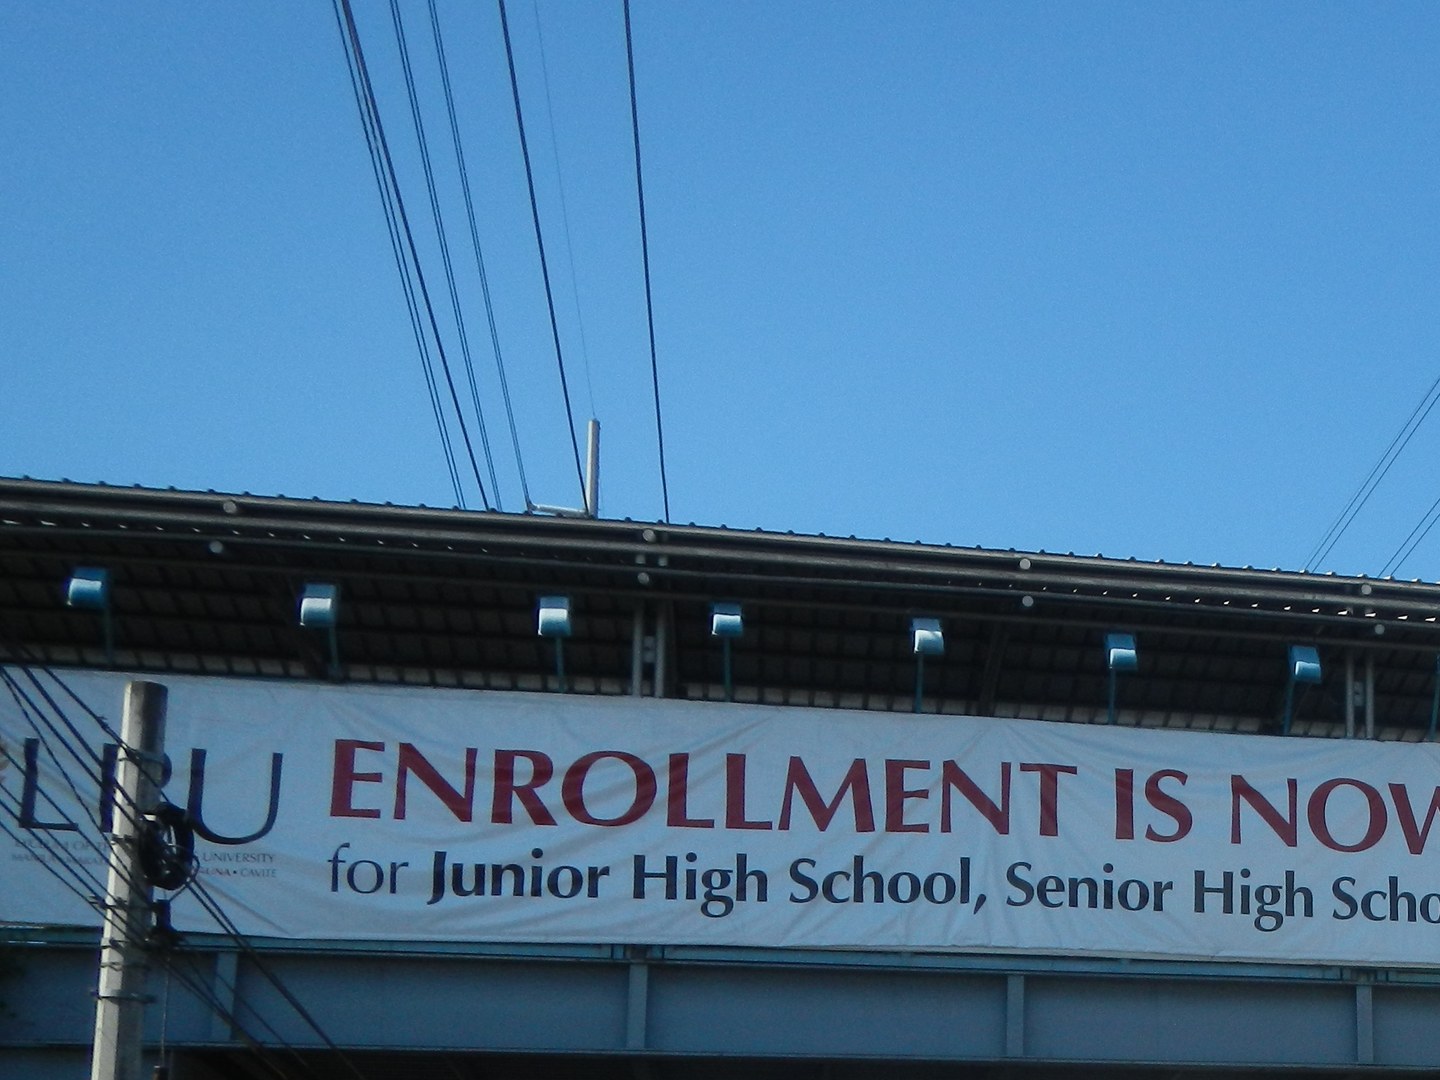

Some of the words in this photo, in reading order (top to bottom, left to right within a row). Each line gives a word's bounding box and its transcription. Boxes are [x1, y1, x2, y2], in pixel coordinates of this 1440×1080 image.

[330, 739, 1077, 836] ENROLLMENT
[1115, 769, 1193, 842] IS
[203, 853, 275, 863] UNIVERSITY
[327, 842, 408, 894] for
[427, 847, 610, 905] Junior
[632, 853, 768, 918] High
[788, 854, 987, 915] School,
[1006, 861, 1173, 912] Senior
[1194, 869, 1314, 932] High
